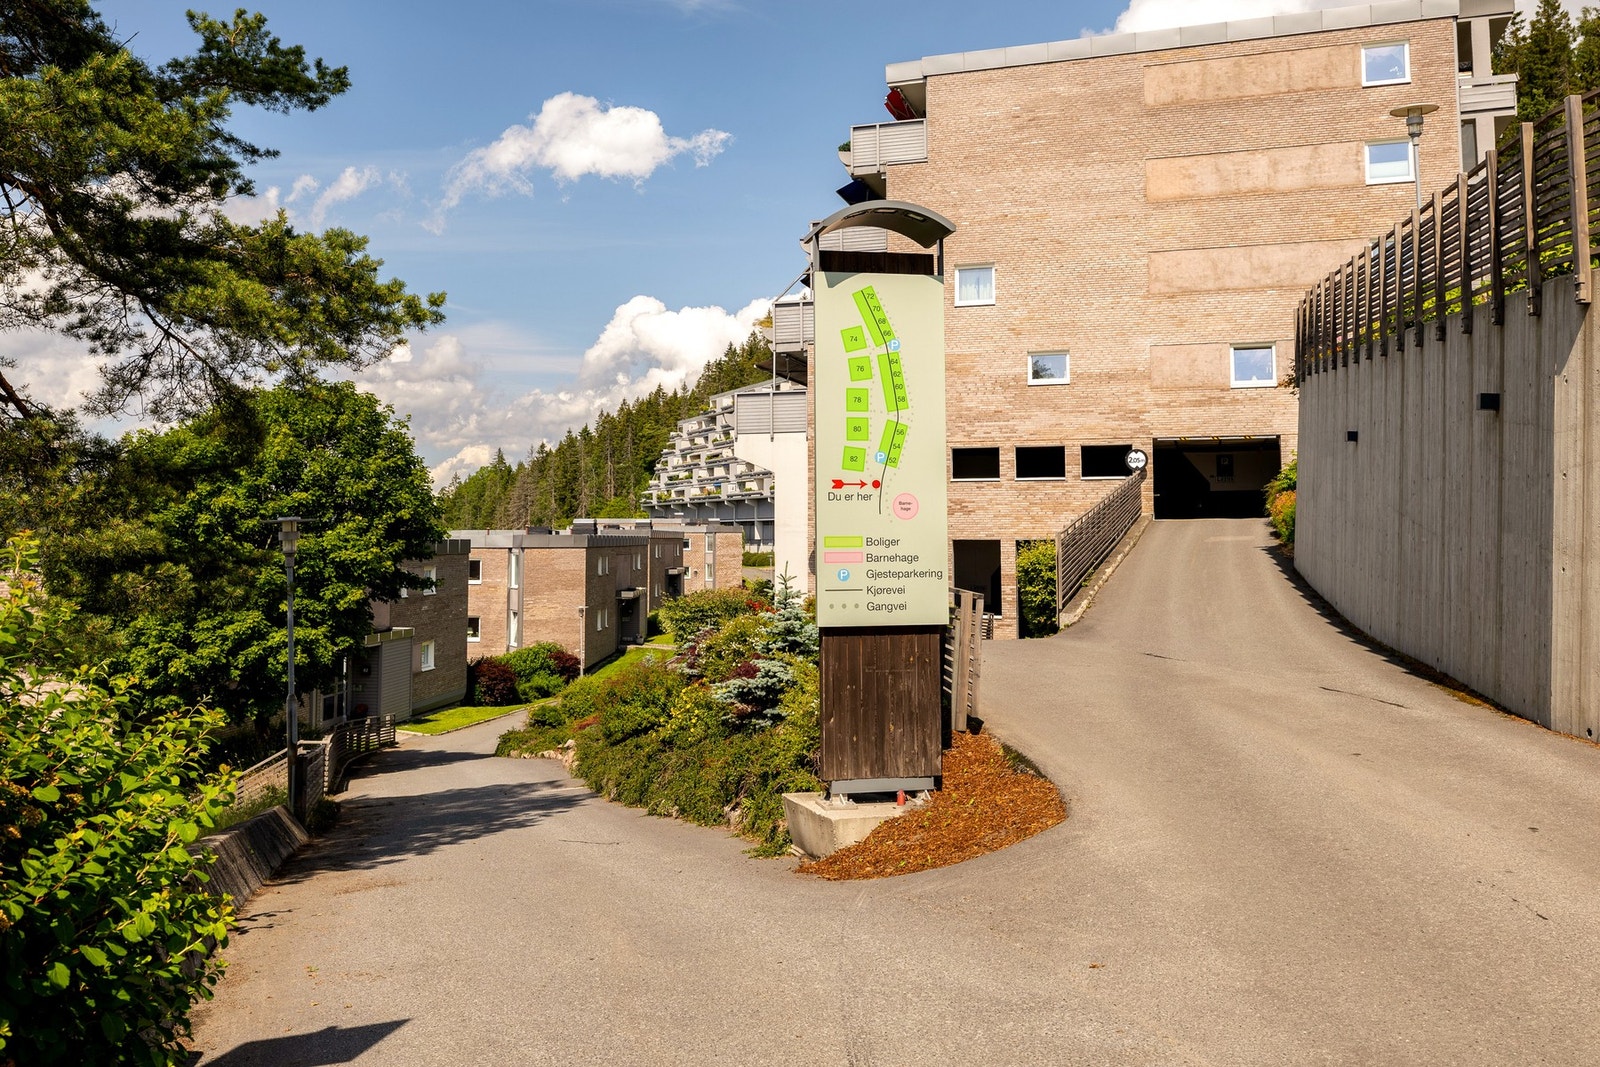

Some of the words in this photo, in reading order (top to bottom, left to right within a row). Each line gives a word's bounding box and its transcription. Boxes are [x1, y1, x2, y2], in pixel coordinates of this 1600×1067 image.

[891, 341, 899, 350] P
[877, 452, 885, 462] P
[827, 491, 842, 501] Du
[844, 493, 856, 501] er
[857, 491, 873, 501] her
[865, 537, 901, 548] Boliger
[866, 553, 920, 564] Barnehage
[840, 569, 848, 580] P
[866, 568, 943, 580] Gjesteparkering
[866, 585, 906, 597] Kjørevei
[866, 601, 907, 613] Gangvei
